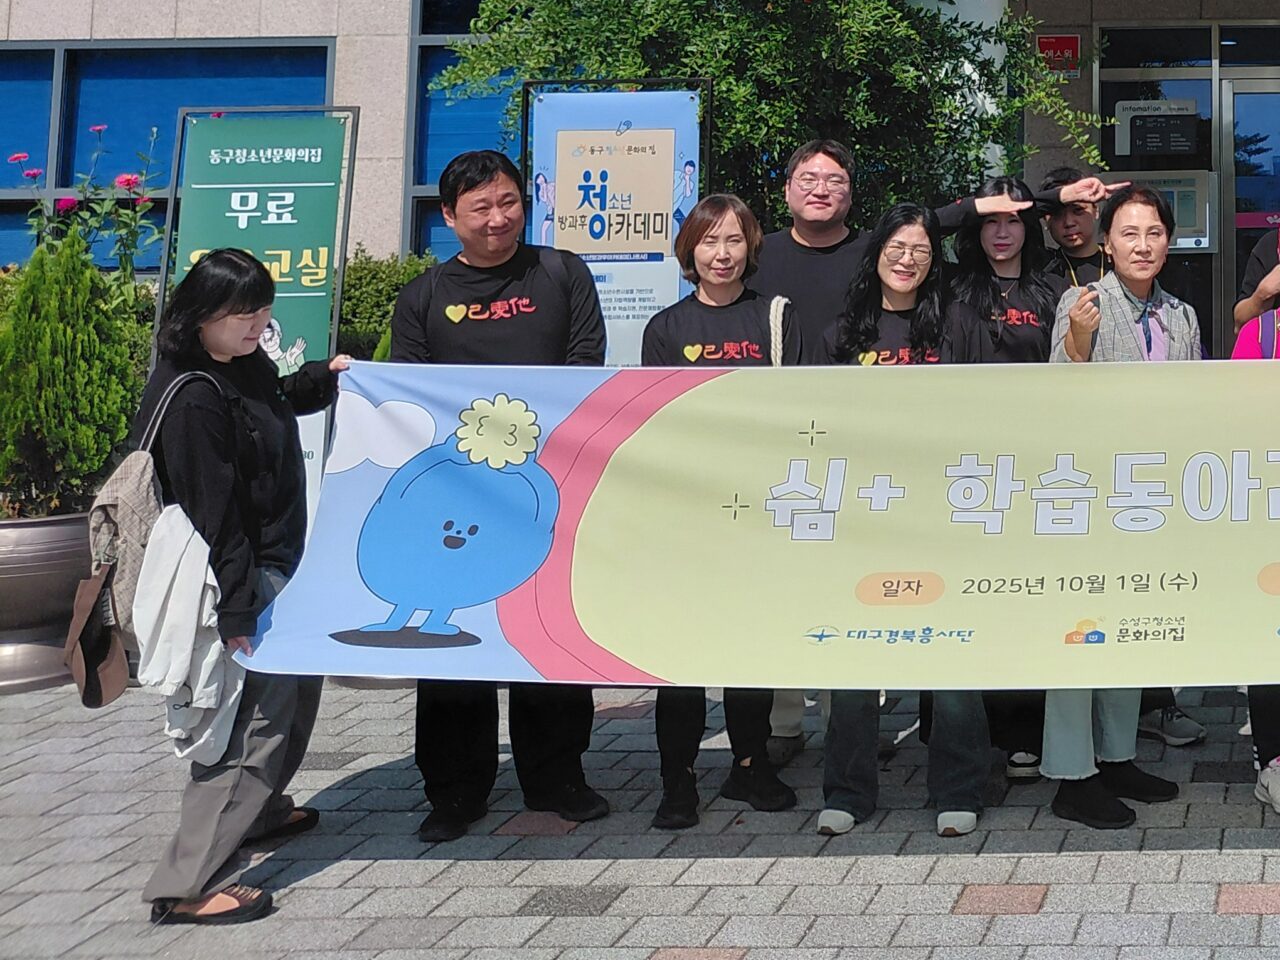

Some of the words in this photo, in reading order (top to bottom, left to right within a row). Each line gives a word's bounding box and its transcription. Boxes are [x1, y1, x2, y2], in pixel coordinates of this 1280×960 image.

[208, 147, 323, 165] 동구청소년문화의집
[225, 191, 298, 230] 무료
[881, 579, 923, 598] 일자
[960, 576, 1046, 596] 2025년
[1055, 574, 1107, 594] 10월
[1116, 572, 1151, 593] 1일
[1159, 570, 1199, 592] (수)
[1119, 616, 1185, 627] 수성구청소년
[846, 626, 976, 645] 대구경북흥사단
[1116, 627, 1185, 643] 문화의집
